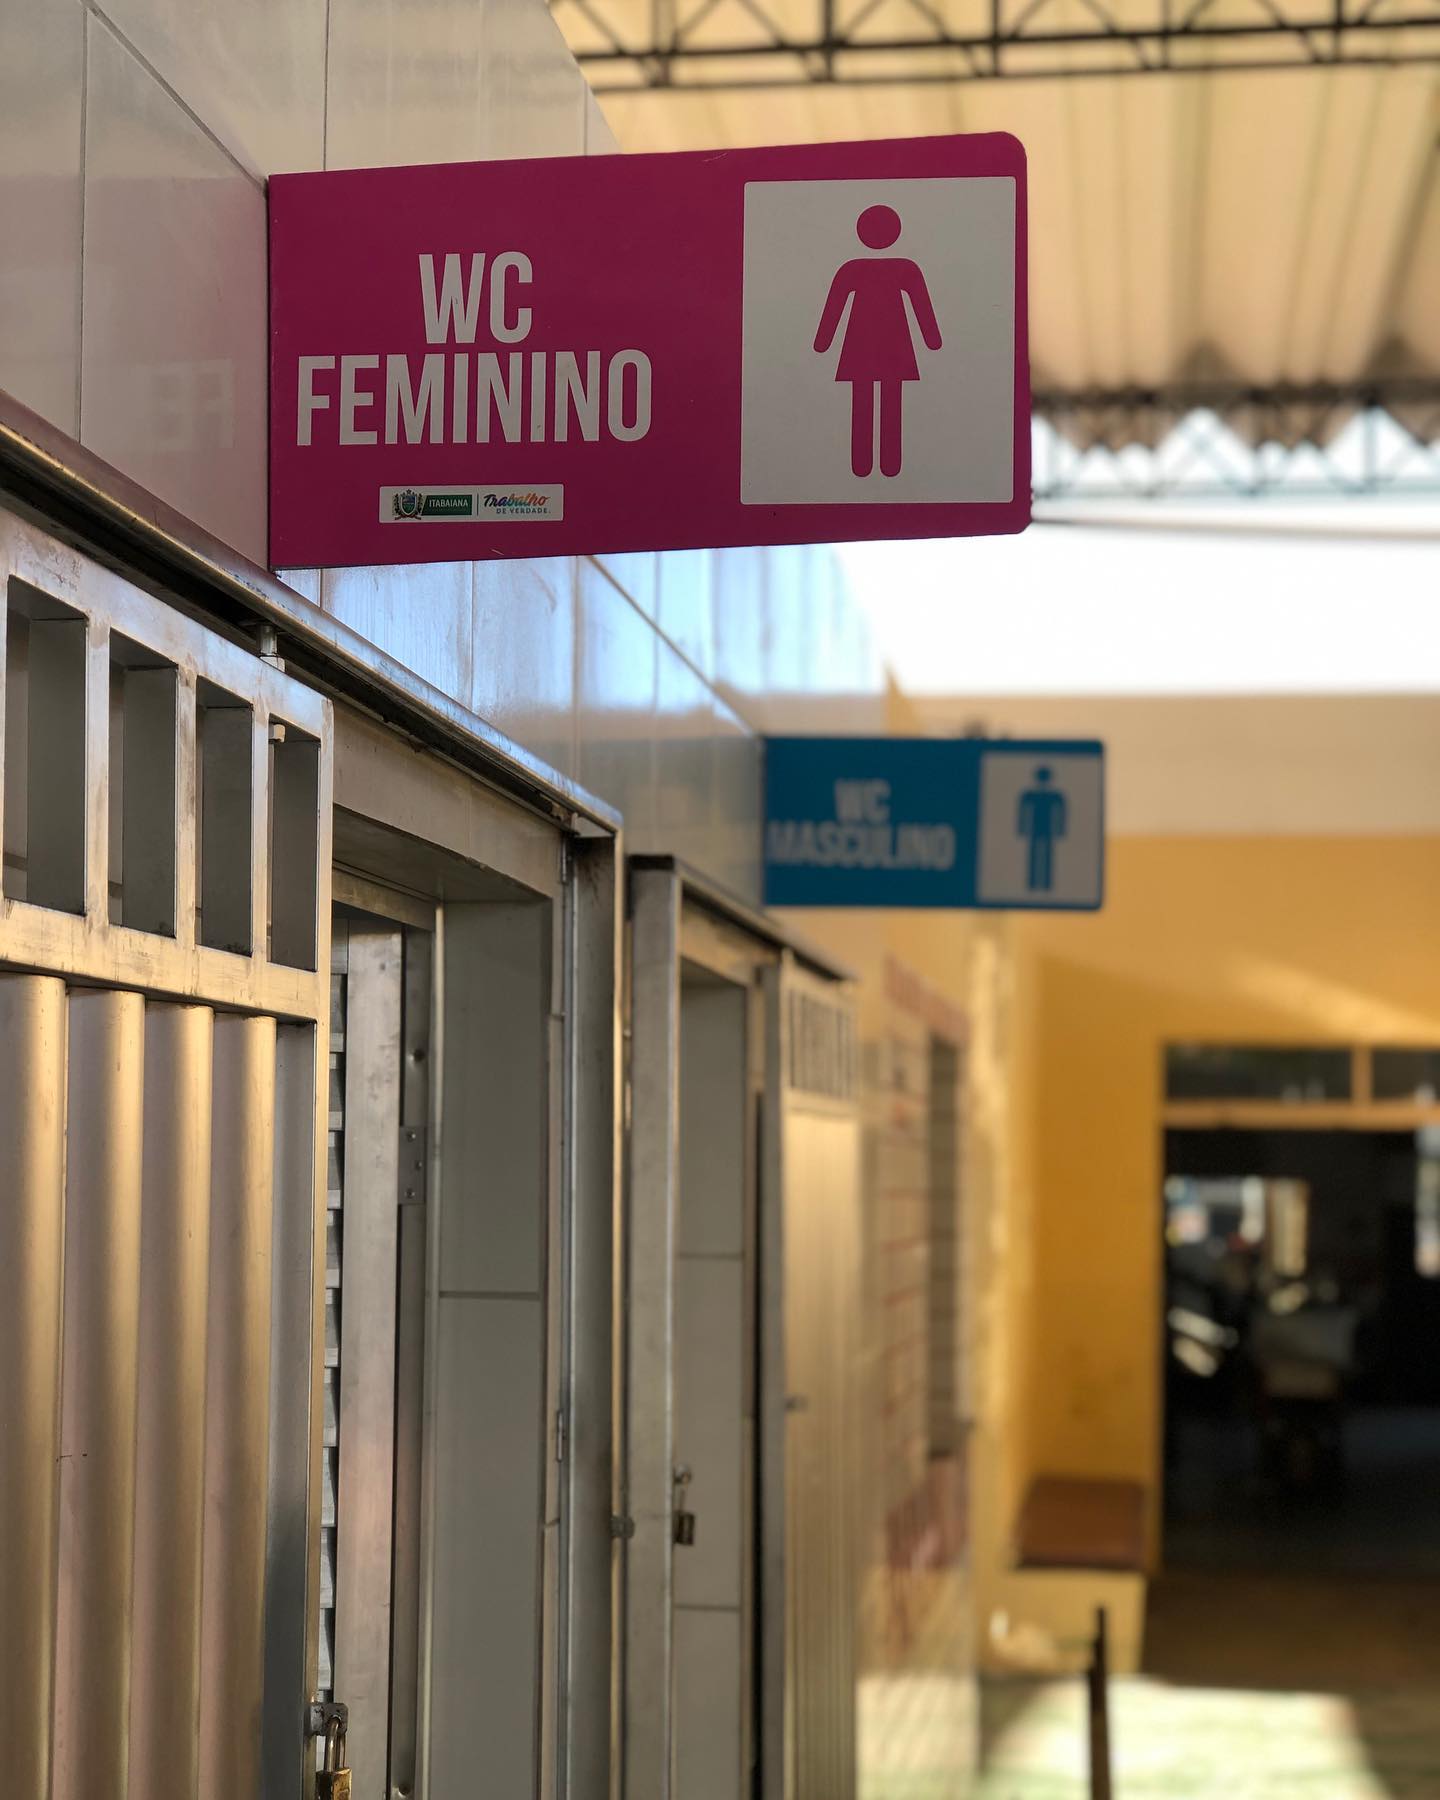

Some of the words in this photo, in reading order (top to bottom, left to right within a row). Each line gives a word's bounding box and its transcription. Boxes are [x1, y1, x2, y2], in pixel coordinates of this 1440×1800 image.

[418, 251, 533, 344] WC
[297, 349, 652, 446] FEMININO
[429, 499, 469, 508] ITABAIANA
[483, 492, 551, 507] Trabalho
[834, 778, 891, 823] WC
[767, 820, 956, 870] MASCULINO
